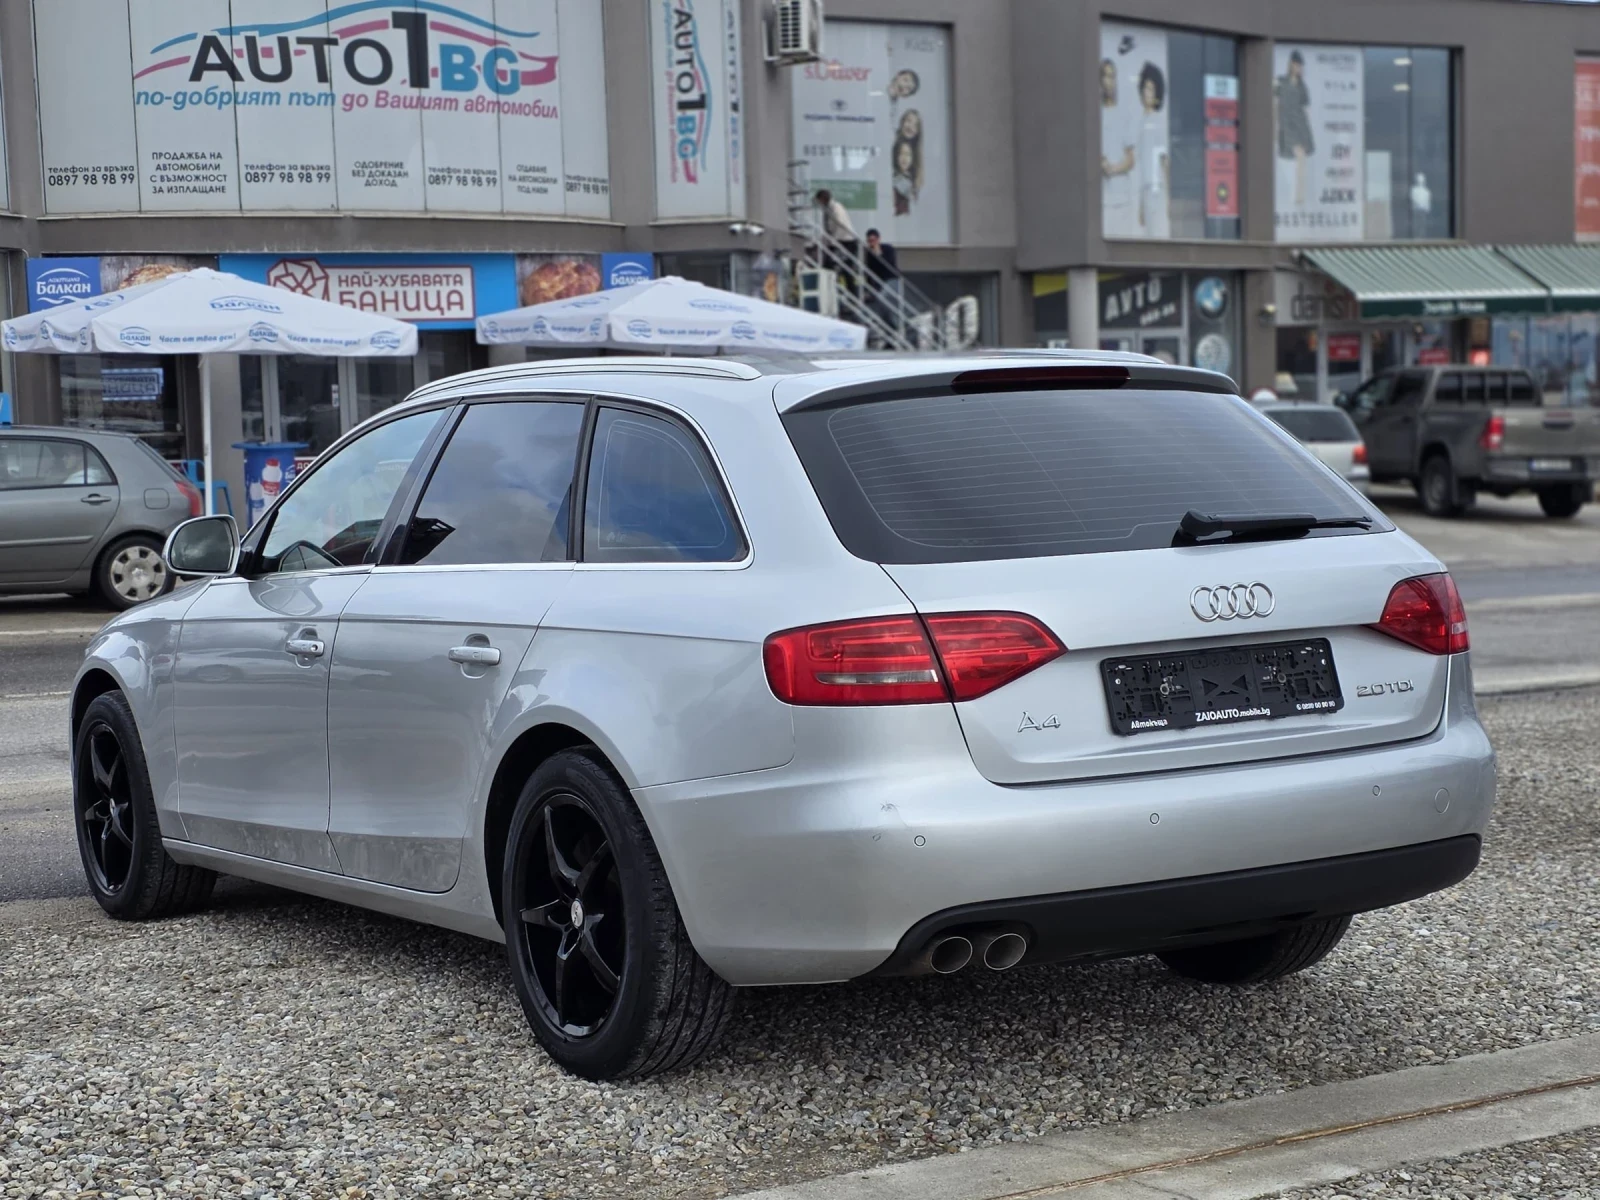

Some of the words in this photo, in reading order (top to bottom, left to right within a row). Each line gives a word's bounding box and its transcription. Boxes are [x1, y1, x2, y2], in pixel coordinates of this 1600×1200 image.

[136, 86, 281, 110] по-добрият
[288, 92, 336, 107] път
[342, 93, 369, 112] до
[375, 90, 458, 111] Вашият
[464, 95, 559, 119] автомобил
[152, 151, 207, 161] ПРОДАЖБА
[209, 151, 223, 160] НА
[48, 166, 90, 175] телефон
[104, 165, 135, 174] връзка
[155, 162, 221, 172] АВТОМОБИЛИ
[244, 163, 287, 171] телефон
[300, 164, 331, 173] връзка
[353, 161, 405, 170] ОДОБРЕНИЕ
[149, 175, 157, 183] С
[160, 174, 228, 183] ВЪЗМОЖНОСТ
[244, 172, 275, 183] 0897
[279, 172, 294, 183] 98
[298, 172, 313, 183] 98
[317, 172, 331, 183] 99
[352, 169, 366, 178] БЕЗ
[367, 170, 409, 179] ДОКАЗАН
[48, 174, 79, 187] 0897
[83, 174, 98, 185] 98
[101, 174, 117, 185] 98
[121, 173, 135, 184] 99
[364, 178, 399, 188] ДОХОД
[428, 174, 452, 186] 0897
[455, 175, 469, 187] 98
[471, 175, 483, 188] 98
[486, 176, 498, 188] 99
[152, 186, 165, 194] ЗА
[167, 185, 227, 195] ИЗПЛАЩАНЕ
[338, 271, 464, 288] НАЙ-ХУБАВАТА
[36, 281, 92, 295] Балкан
[338, 289, 465, 316] БАНИЦА
[1017, 711, 1061, 733] A4
